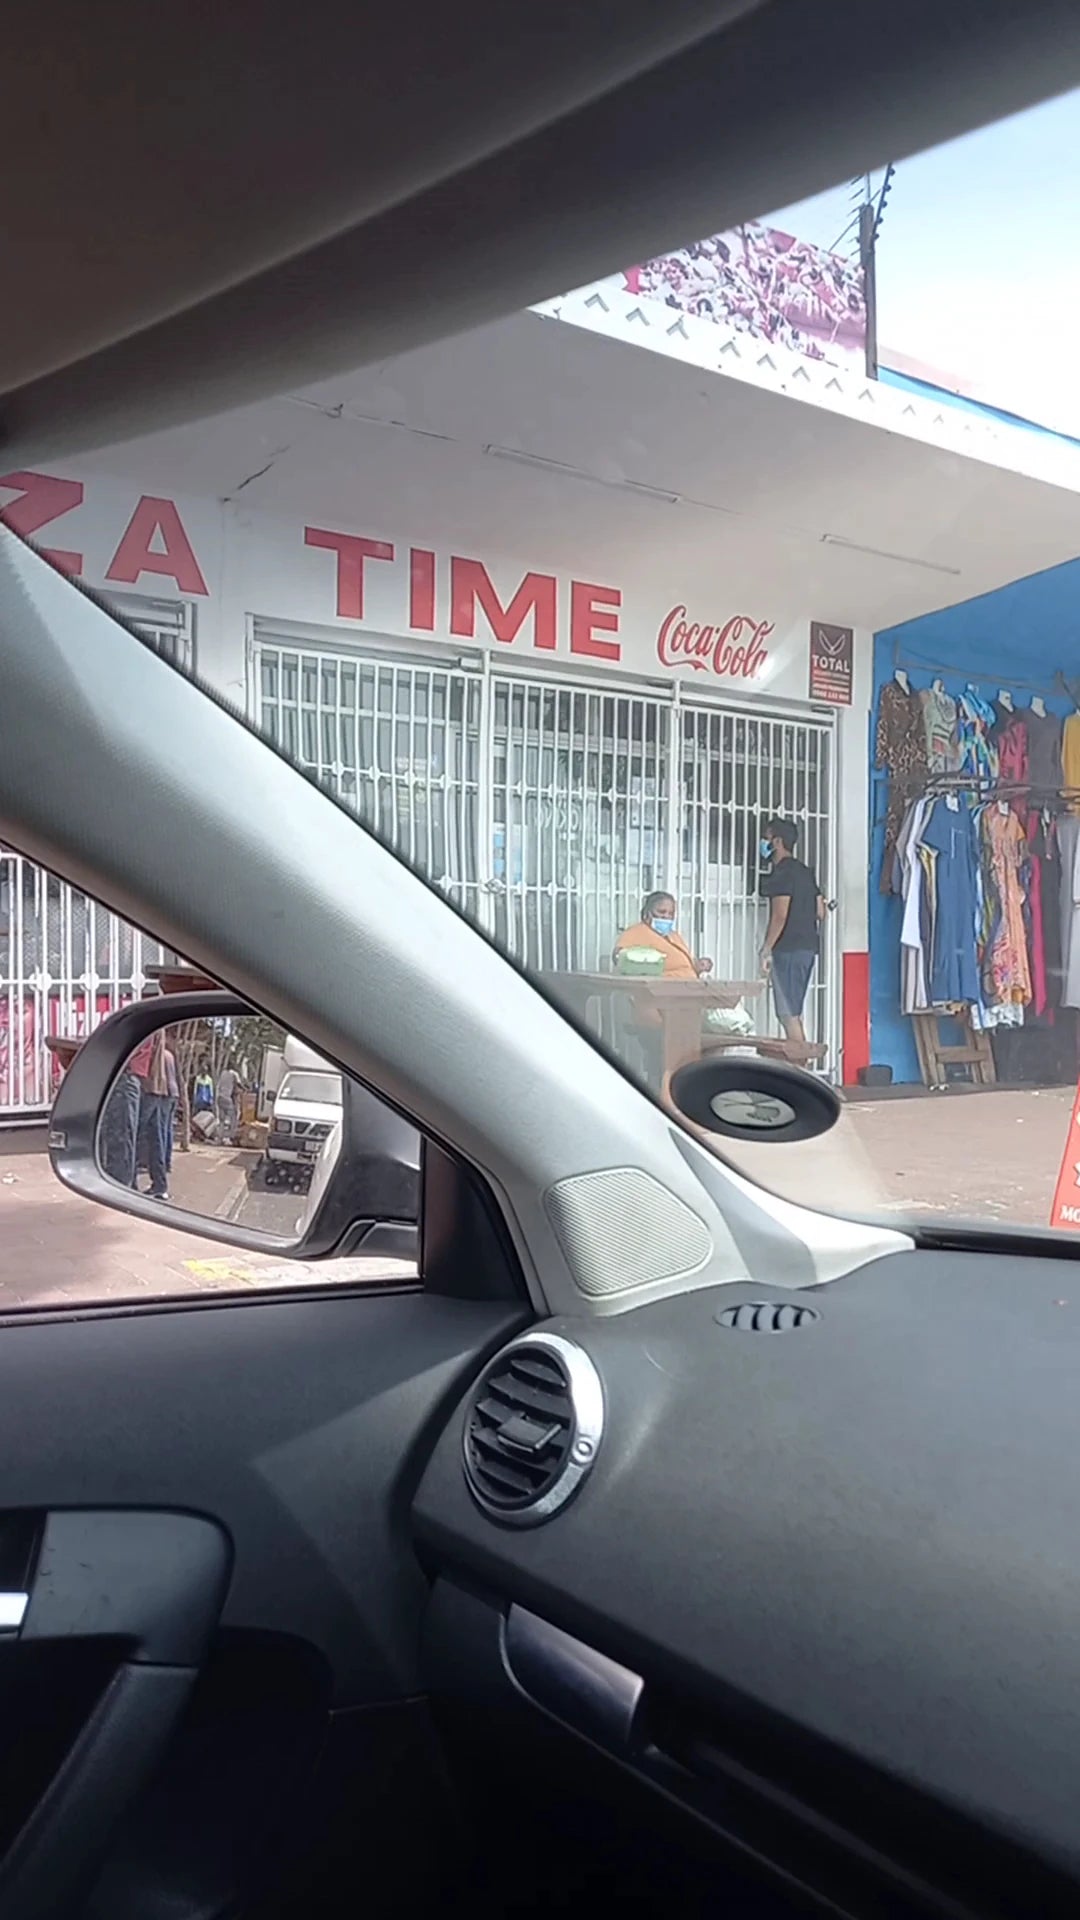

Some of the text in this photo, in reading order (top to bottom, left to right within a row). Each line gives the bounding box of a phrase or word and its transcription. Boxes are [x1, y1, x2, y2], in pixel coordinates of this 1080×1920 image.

[304, 525, 622, 662] TIME
[657, 604, 776, 679] Coca-Cola
[811, 654, 850, 673] TOTAL
